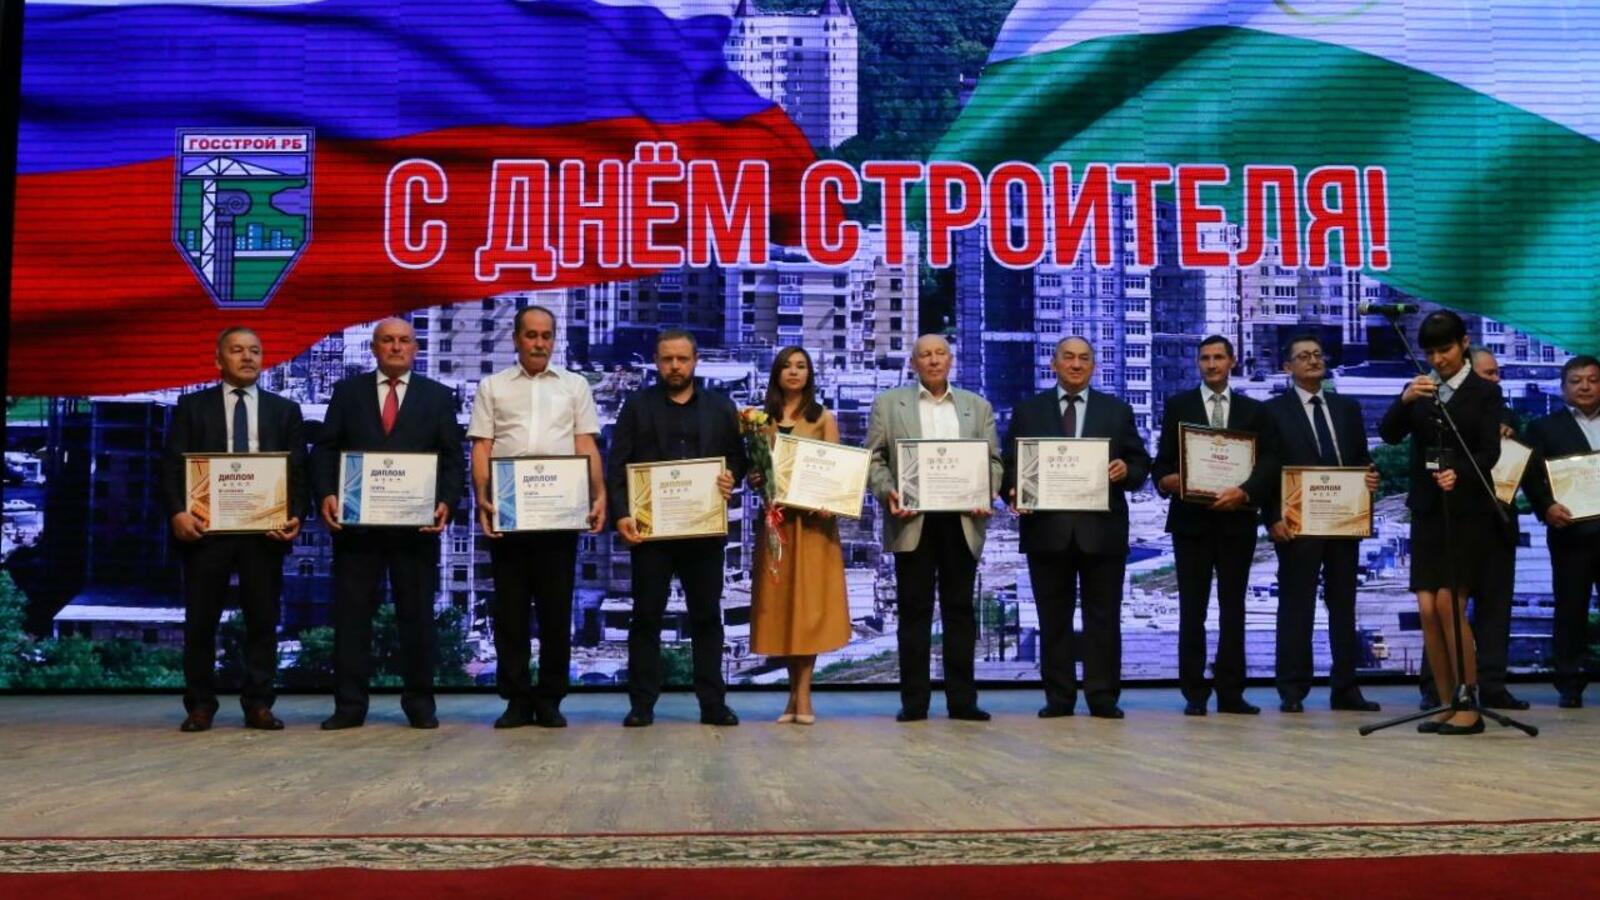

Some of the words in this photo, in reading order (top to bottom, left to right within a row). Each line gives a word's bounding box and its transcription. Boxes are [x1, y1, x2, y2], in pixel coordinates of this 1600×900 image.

[188, 136, 276, 150] ГОССТРОЙ
[281, 138, 303, 150] РБ
[384, 157, 448, 269] С
[474, 141, 771, 282] ДНЁМ
[799, 159, 1392, 271] СТРОИТЕЛЯ!
[218, 473, 255, 482] ДИПЛОМ
[370, 469, 406, 477] ДИПЛОМ
[522, 474, 558, 483] ДИПЛОМ
[1309, 484, 1342, 492] ДИПЛОМ
